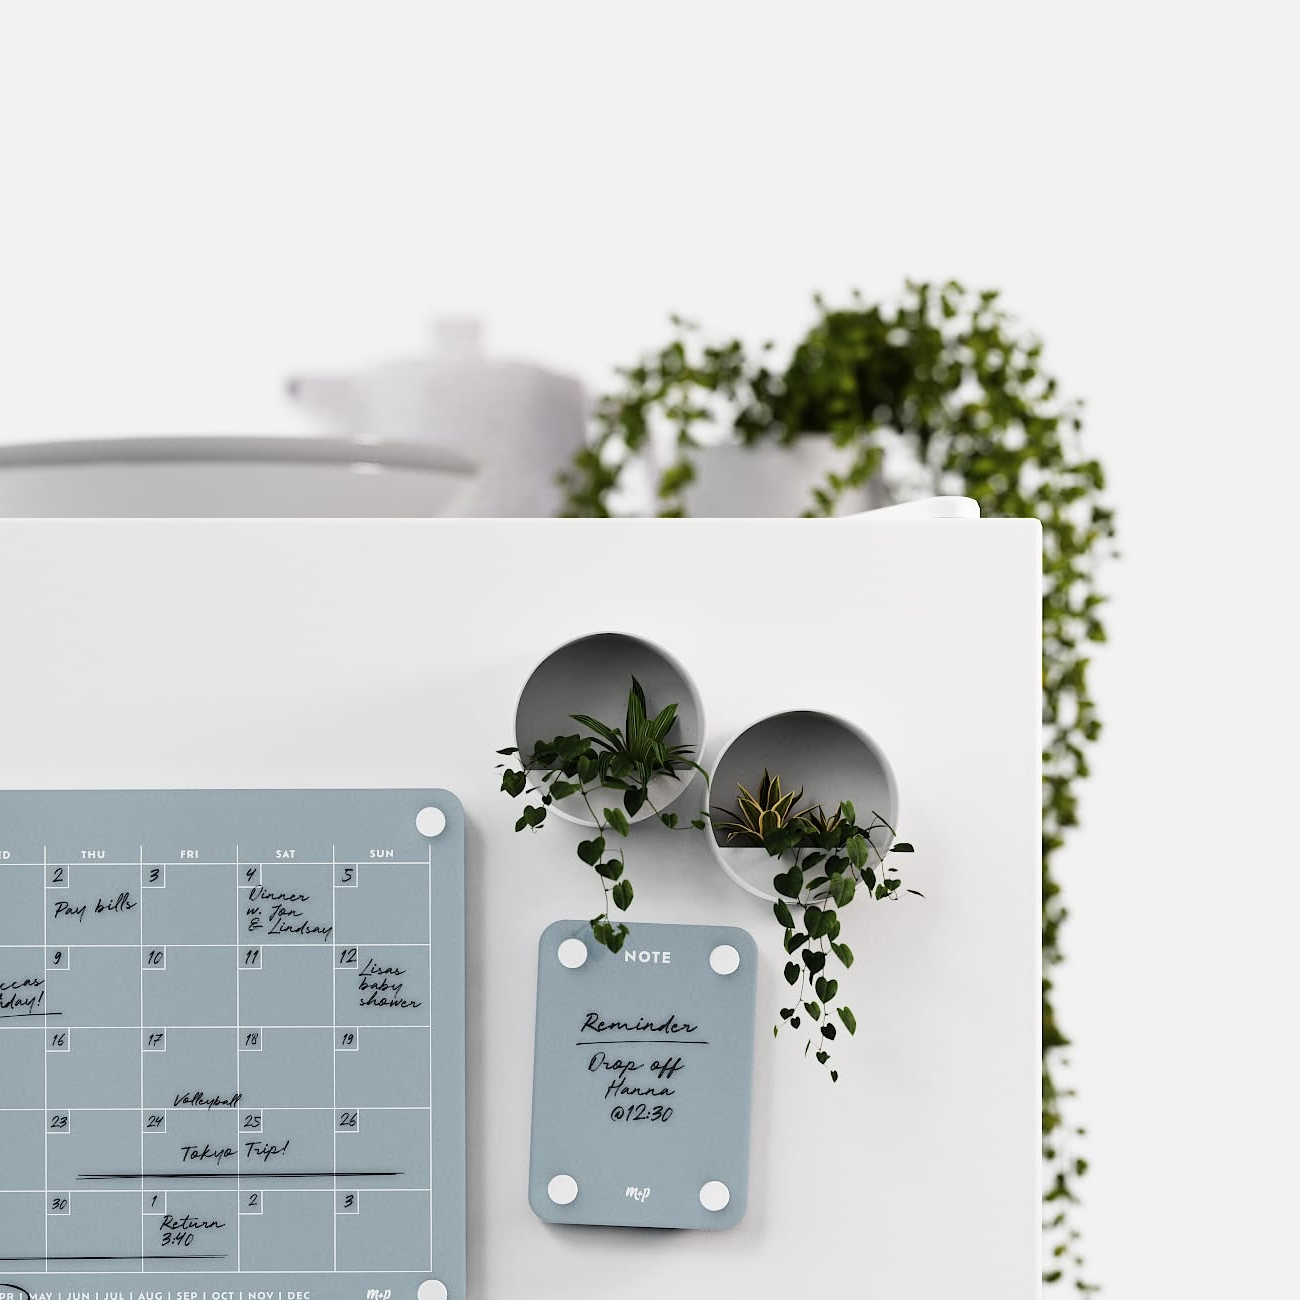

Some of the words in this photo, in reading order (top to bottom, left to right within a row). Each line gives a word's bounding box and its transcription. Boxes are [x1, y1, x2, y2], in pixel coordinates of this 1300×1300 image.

[80, 849, 106, 860] THU
[180, 849, 199, 860] FRI
[275, 849, 296, 859] SAT
[369, 848, 394, 859] SUN
[51, 868, 64, 882] 2
[149, 869, 160, 882] 3
[245, 868, 257, 881] 4
[341, 869, 354, 882] 5
[55, 902, 86, 922] Pay
[95, 892, 137, 913] bills
[269, 904, 303, 921] Jon
[268, 918, 332, 942] Lindsay
[52, 952, 63, 964] 9
[148, 950, 163, 964] 10
[245, 950, 259, 964] 11
[340, 949, 356, 963] 12
[624, 949, 671, 964] NOTE
[359, 958, 406, 976] Lisas
[358, 977, 403, 998] baby
[360, 989, 422, 1008] shower
[581, 1013, 698, 1034] Reminder
[52, 1034, 65, 1046] 16
[149, 1034, 163, 1046] 17
[246, 1033, 258, 1045] 18
[343, 1034, 354, 1045] 19
[588, 1052, 644, 1079] Drop
[650, 1057, 684, 1079] off
[605, 1077, 675, 1099] Hanna
[174, 1092, 242, 1110] Volleyball
[51, 1116, 67, 1128] 23
[147, 1116, 164, 1127] 24
[244, 1115, 261, 1127] 25
[340, 1113, 357, 1126] 26
[181, 1145, 238, 1165] Tokyo
[245, 1140, 289, 1161] Trip!
[52, 1199, 67, 1209] 30
[151, 1195, 158, 1207] 1
[248, 1194, 258, 1206] 2
[343, 1195, 355, 1208] 3
[160, 1215, 225, 1230] Return
[103, 1291, 125, 1300] JUL
[137, 1290, 163, 1300] AUG
[176, 1291, 198, 1300] SEP
[211, 1291, 235, 1300] OCT
[248, 1291, 275, 1300] NOV
[287, 1291, 311, 1300] DEC
